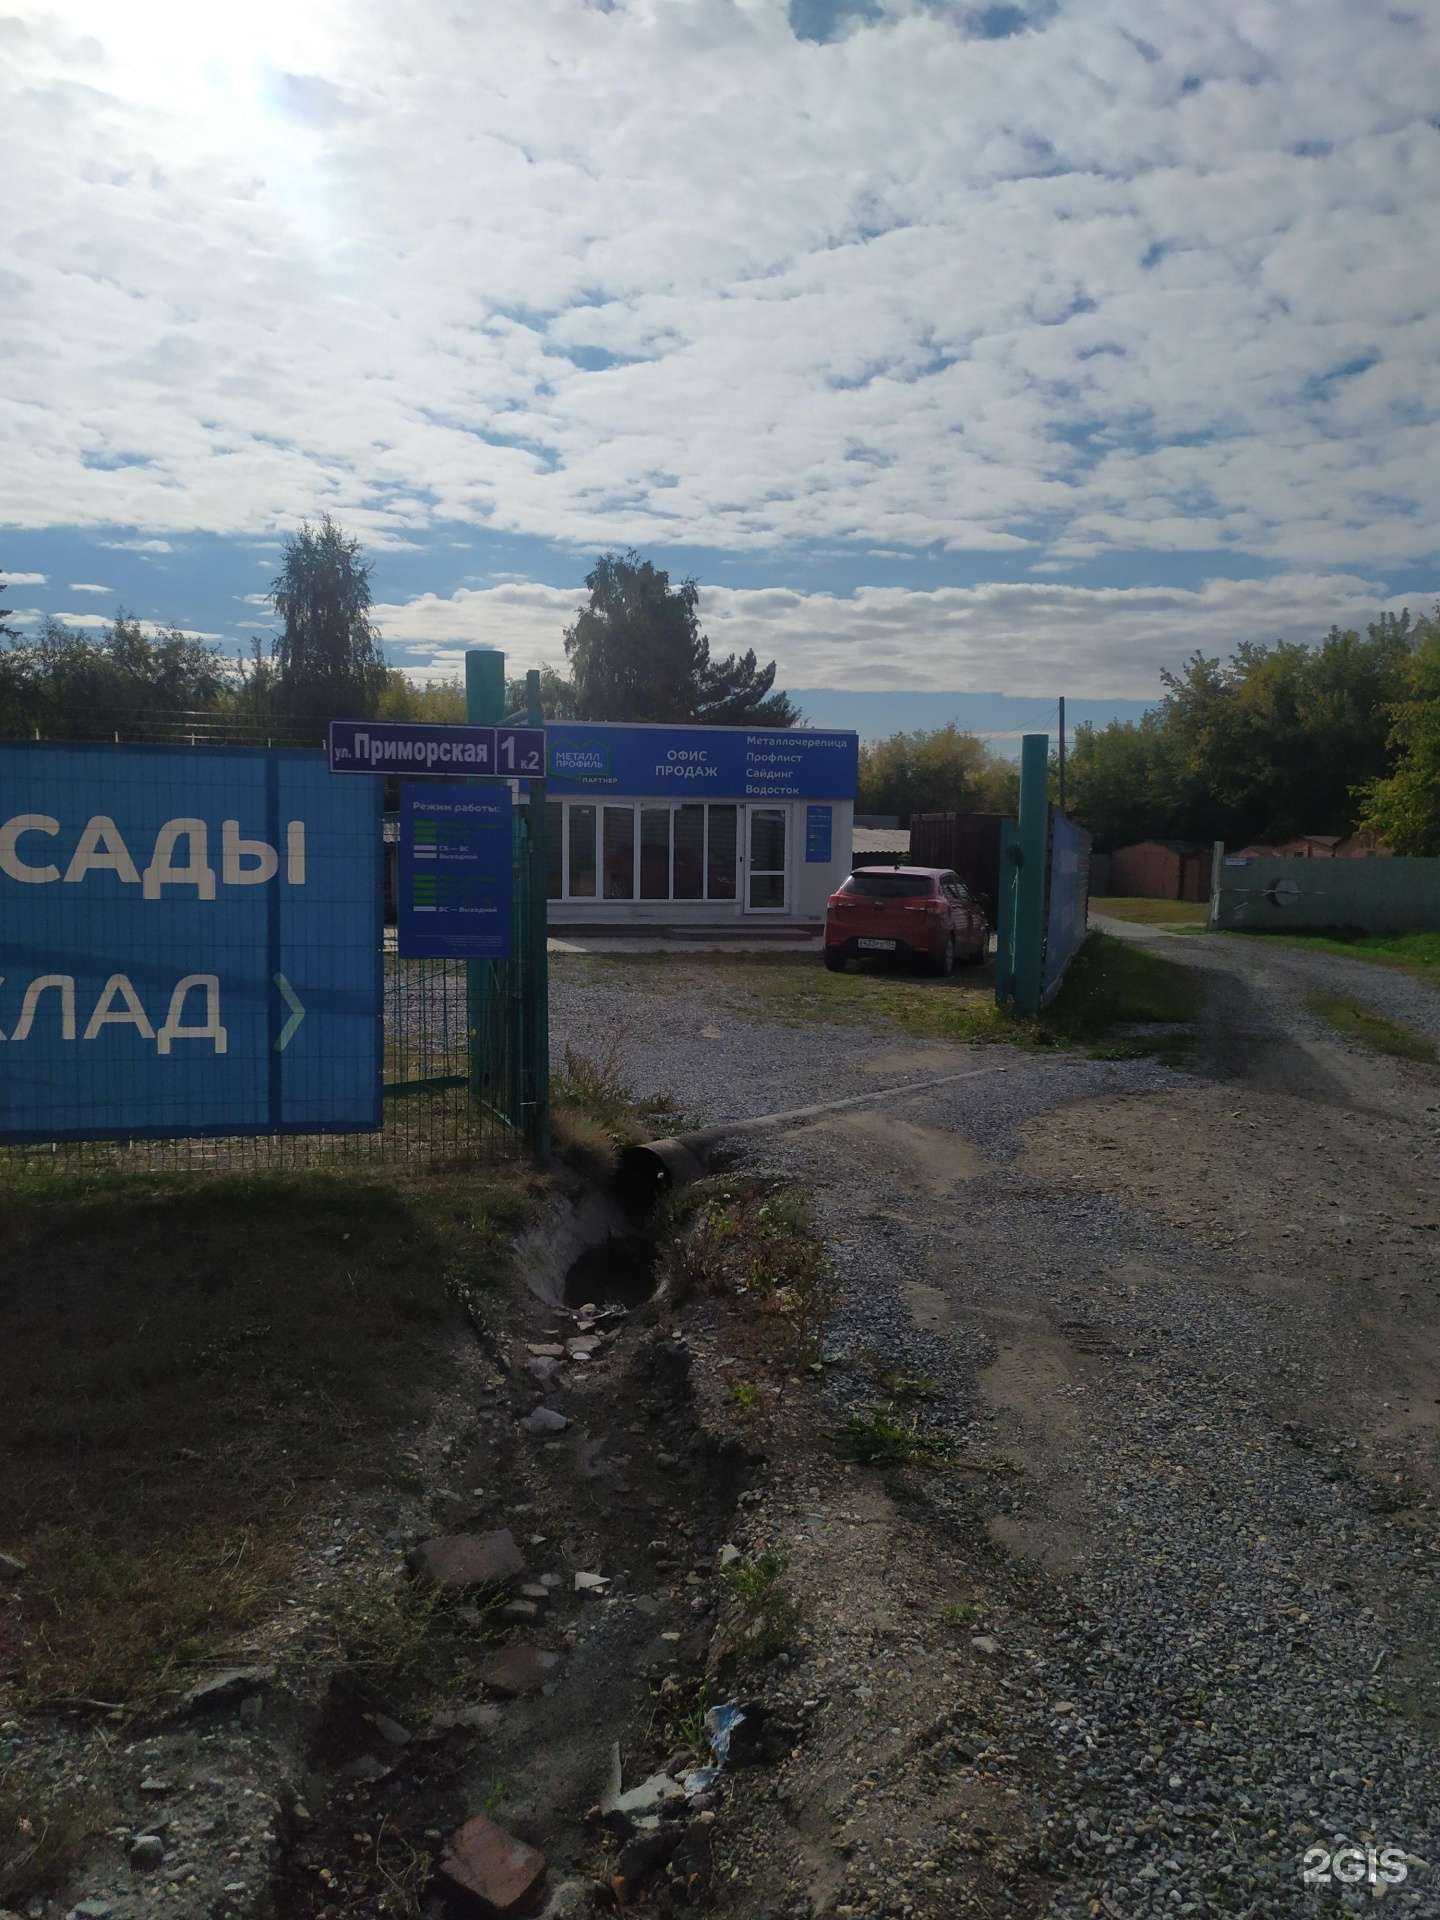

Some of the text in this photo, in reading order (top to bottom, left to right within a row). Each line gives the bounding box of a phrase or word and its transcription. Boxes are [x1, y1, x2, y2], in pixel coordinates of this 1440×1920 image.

[746, 735, 848, 749] Металлочерепица
[333, 732, 488, 768] ул. Приморская
[501, 736, 515, 769] 1
[556, 751, 601, 761] МЕТАЛЛ
[666, 750, 708, 762] ОФИС
[746, 752, 803, 764] Профлист
[556, 760, 604, 769] ПРОФИЛЬ
[655, 765, 718, 778] ПРОДАЖ
[745, 767, 794, 779] Сайдинг
[581, 776, 618, 784] ПАРТНЕР
[745, 784, 800, 795] Водосток
[413, 800, 452, 813] Режим
[0, 973, 228, 1055] ЛАД
